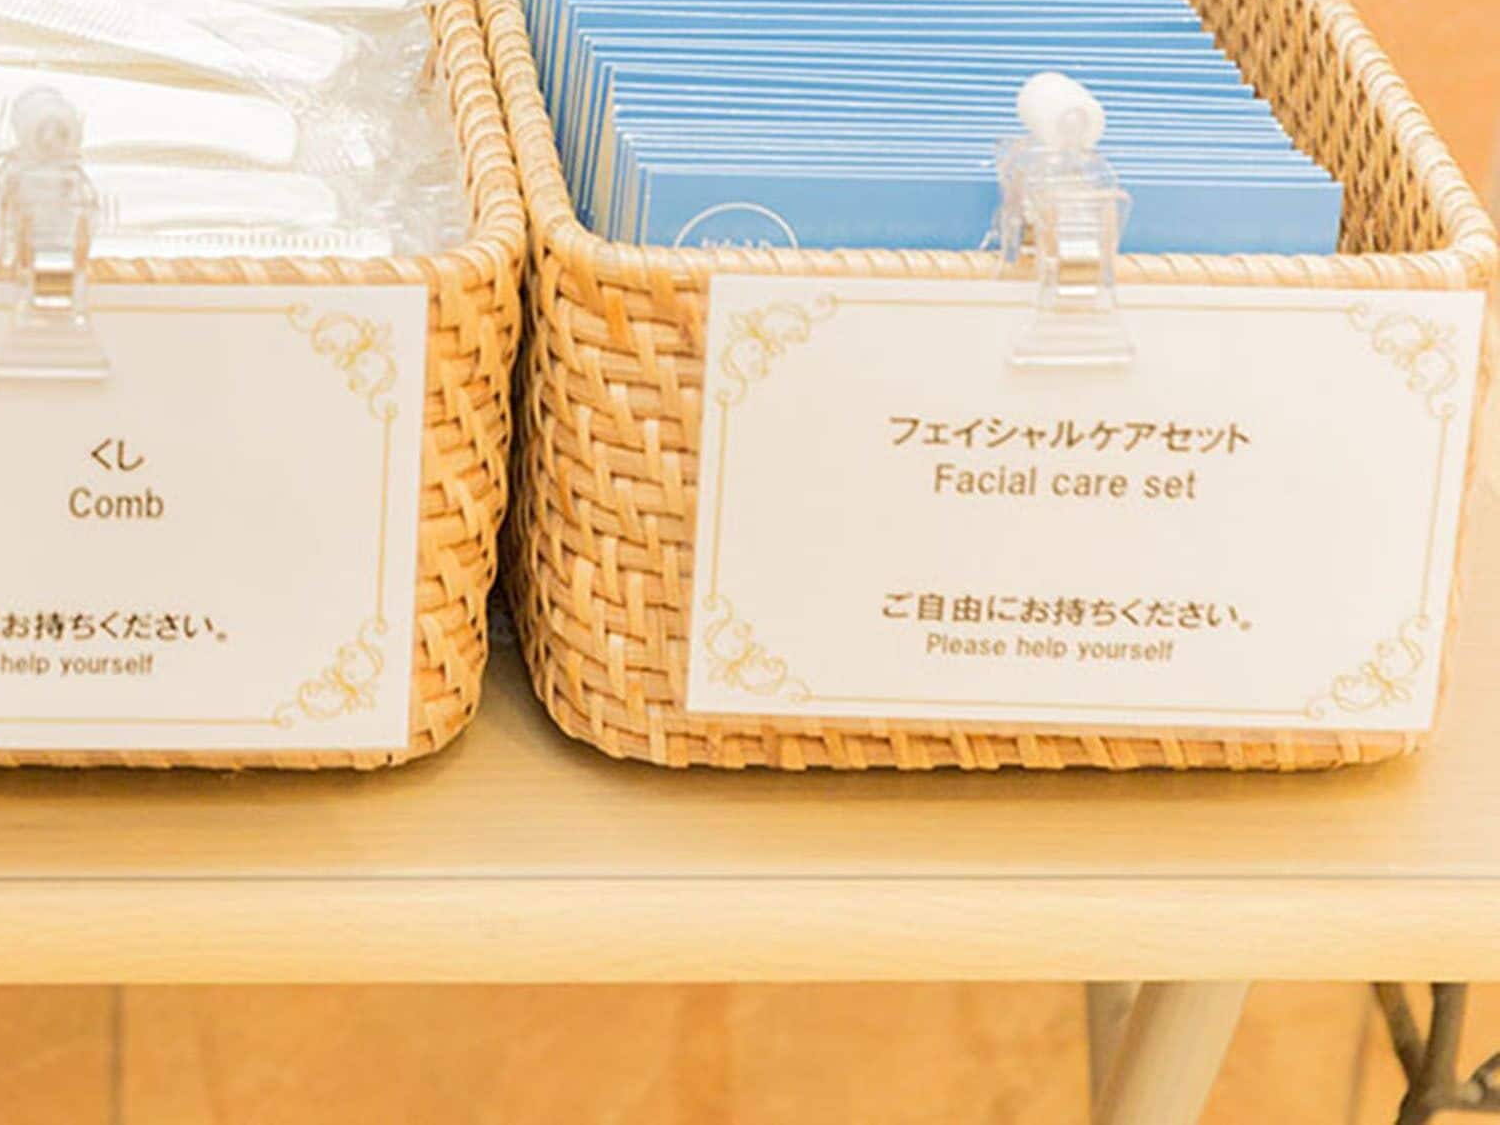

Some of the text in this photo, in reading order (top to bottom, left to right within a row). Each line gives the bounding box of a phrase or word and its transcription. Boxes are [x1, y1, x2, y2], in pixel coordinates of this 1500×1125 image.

[889, 416, 1251, 453] フェイシャルケアセット
[90, 438, 145, 472] くし
[933, 463, 1197, 500] Facial care set
[68, 486, 164, 519] Comb
[882, 592, 1251, 631] ご自由にお持ちください。
[926, 632, 1174, 662] Please help yourself
[0, 652, 51, 676] help
[59, 654, 154, 677] yourself
